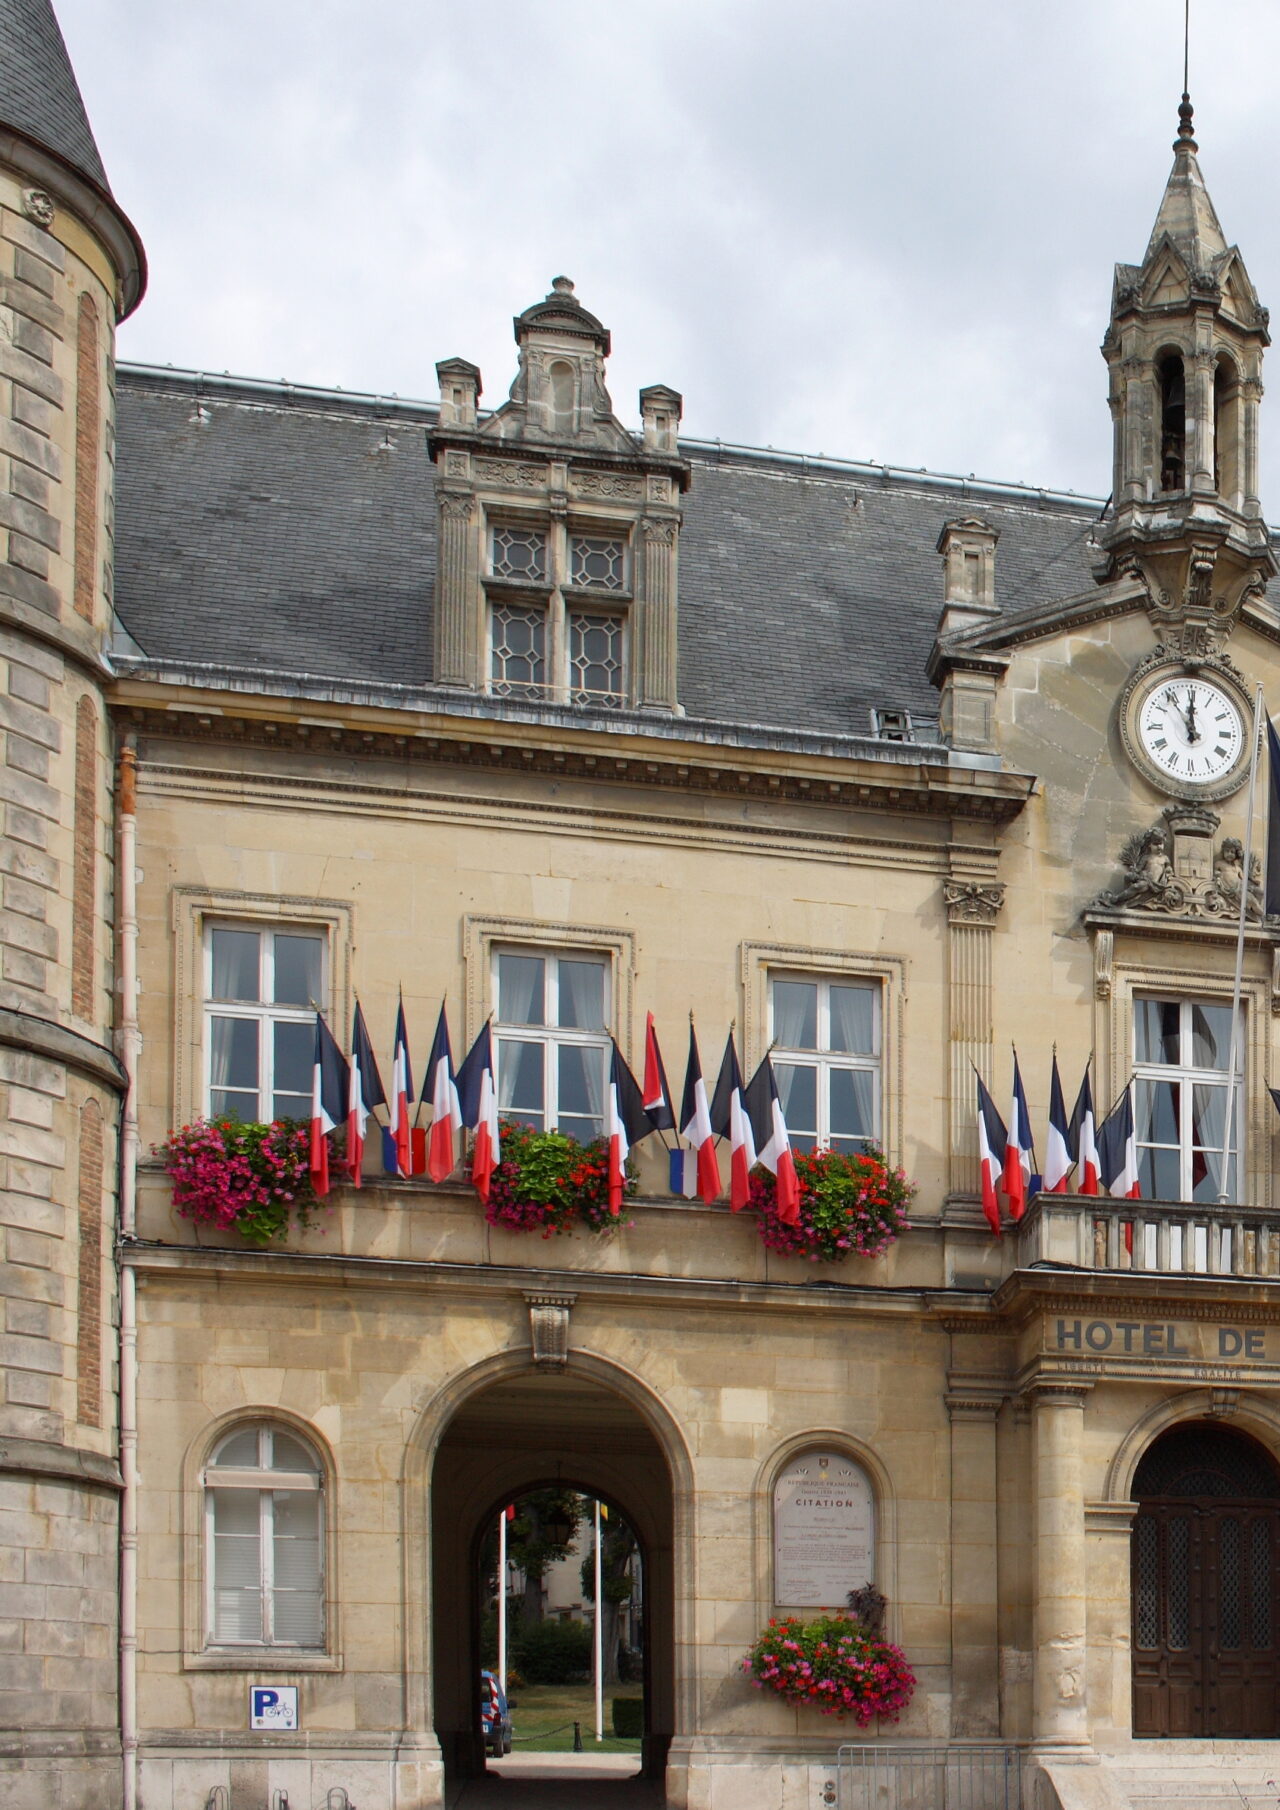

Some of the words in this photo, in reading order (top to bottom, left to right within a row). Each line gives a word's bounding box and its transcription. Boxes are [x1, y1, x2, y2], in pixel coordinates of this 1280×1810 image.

[1056, 1320, 1188, 1354] HOTEL
[1218, 1328, 1266, 1359] DE
[795, 1498, 853, 1508] CITATION
[254, 1690, 279, 1717] P
